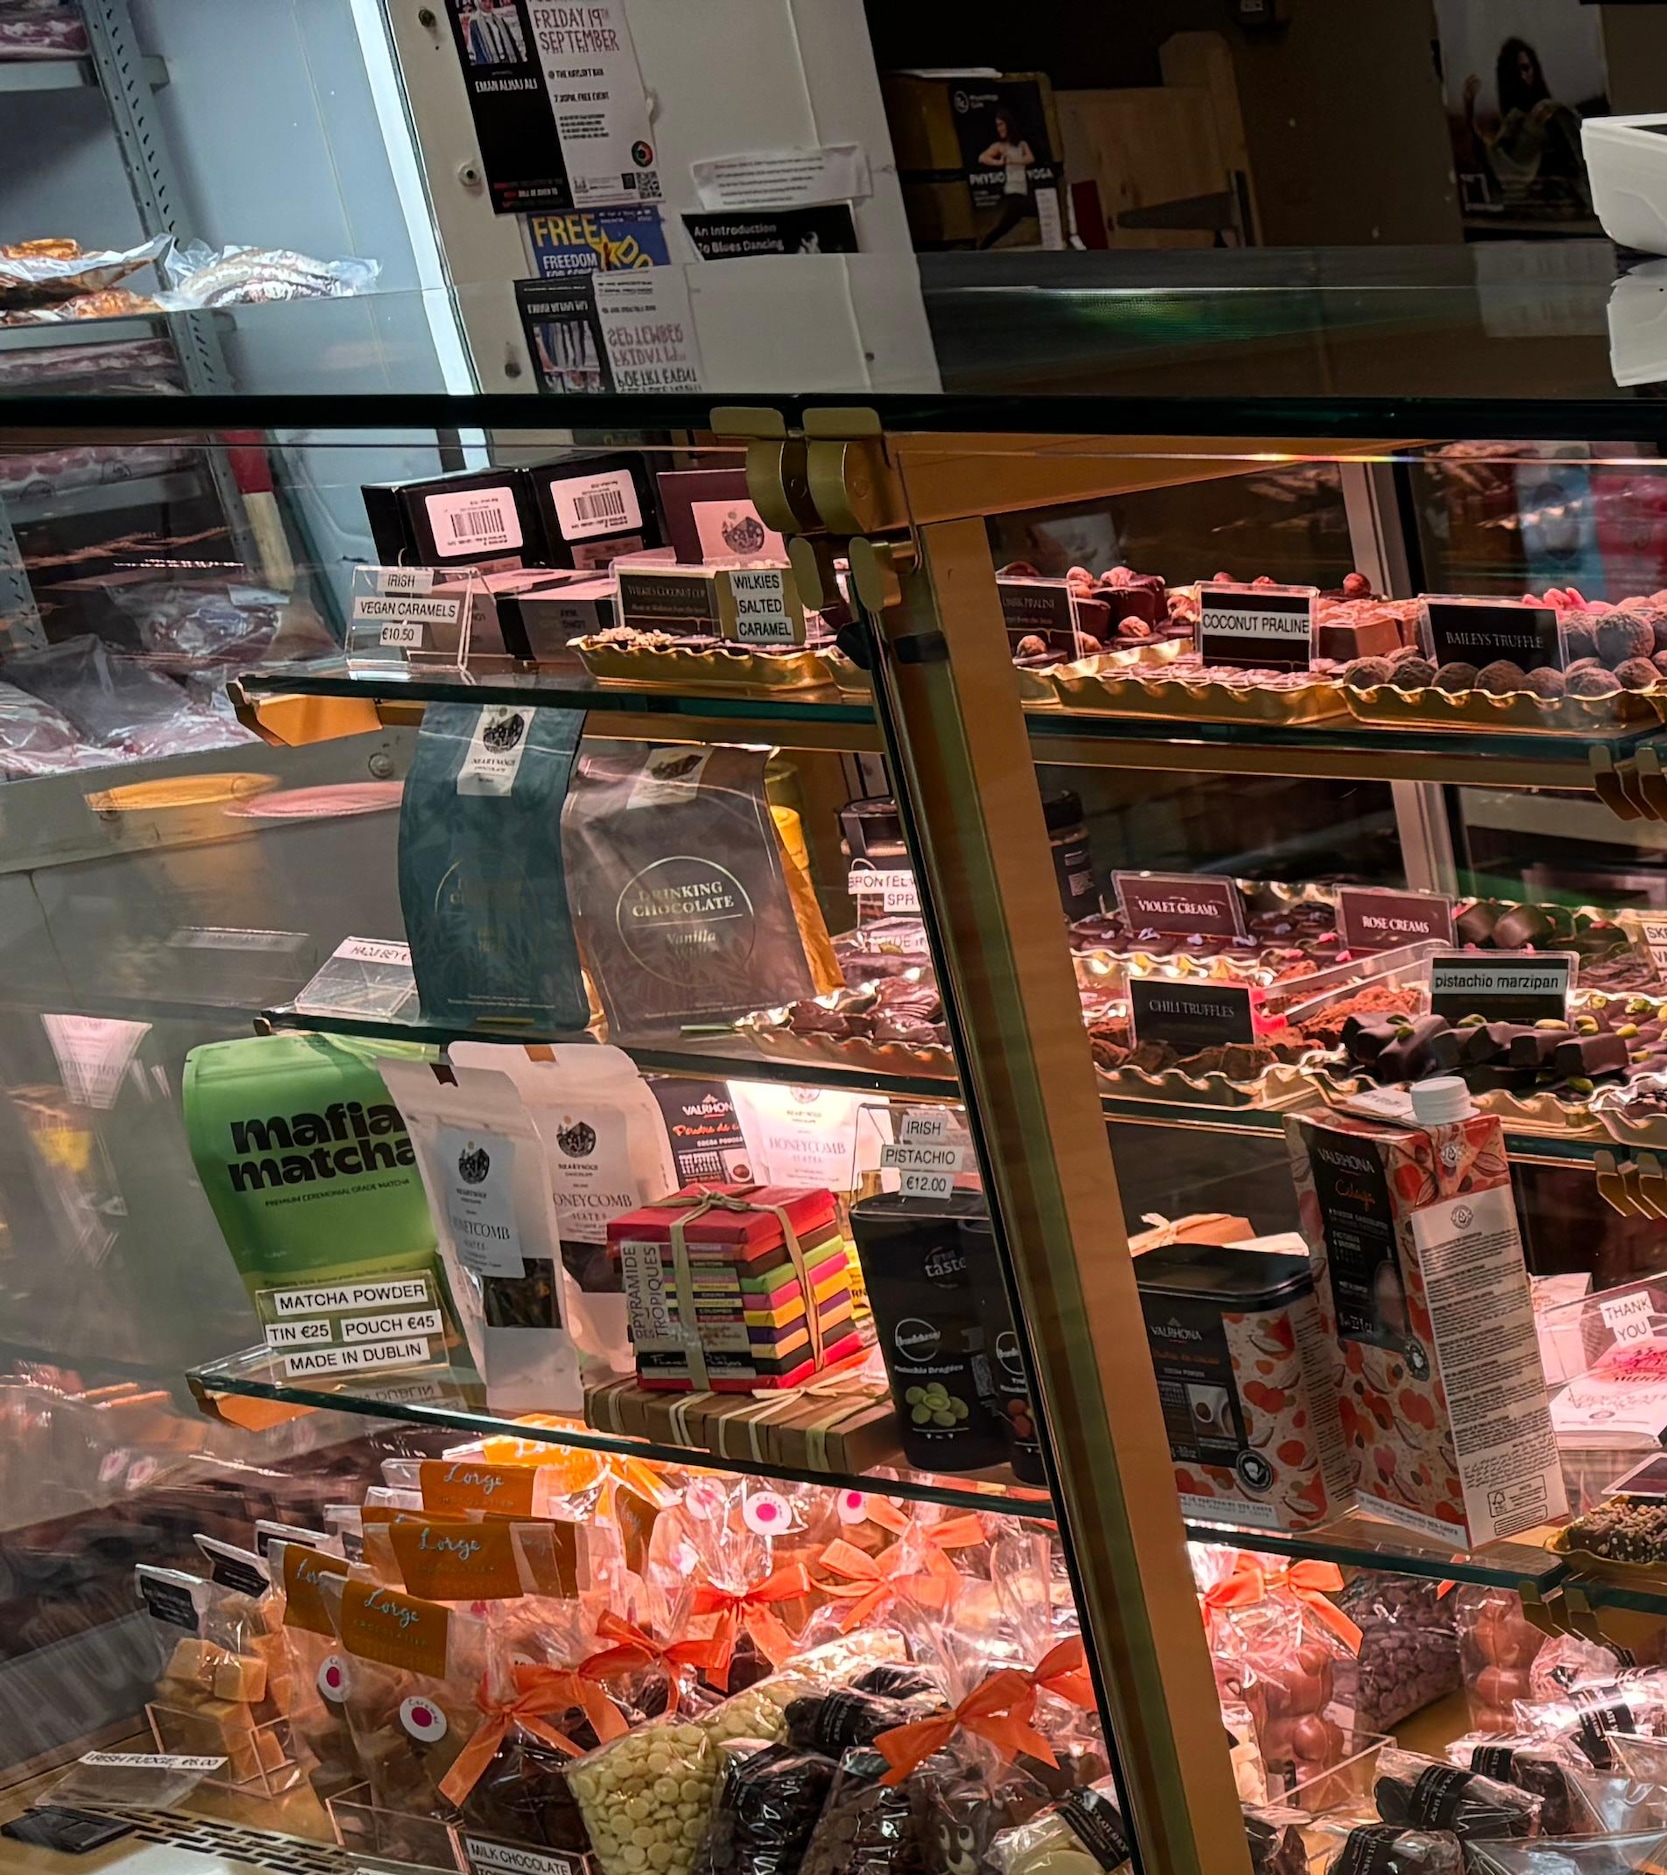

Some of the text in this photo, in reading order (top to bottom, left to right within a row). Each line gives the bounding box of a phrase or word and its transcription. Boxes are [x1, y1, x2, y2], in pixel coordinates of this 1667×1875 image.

[539, 29, 620, 53] SEPTEMBER
[694, 223, 777, 237] An Introduction
[712, 240, 742, 254] Blues
[743, 236, 785, 252] Dancing
[543, 252, 599, 270] FREEDOM
[387, 573, 415, 588] IRISH
[733, 573, 780, 590] WILKIES
[360, 601, 456, 619] VEGAN CARAMELS
[739, 598, 782, 615] SALTED
[738, 620, 792, 638] CARAMEL
[1202, 613, 1310, 635] COCONUT PRALINE
[381, 627, 415, 643] €10.50
[1446, 630, 1544, 650] BAILEYS TRUFFLE
[638, 881, 724, 901] DRINKING
[632, 895, 735, 919] CHOCOLATE
[666, 928, 717, 946] Vanilla
[1434, 973, 1559, 992] pistachio marzipan
[230, 1102, 403, 1154] mafia
[906, 1122, 942, 1136] IRISH
[228, 1137, 418, 1192] matcha
[885, 1149, 956, 1165] PISTACHIO
[1317, 1147, 1375, 1175] VALRHONA
[906, 1175, 947, 1193] €12.00
[279, 1282, 425, 1311] MATCHA POWDER
[1604, 1299, 1651, 1321] THANK
[269, 1322, 329, 1341] TIN €25
[344, 1314, 435, 1337] POUCH €45
[1616, 1321, 1648, 1342] YOU
[290, 1342, 422, 1371] MADE IN DUBLIN
[470, 1843, 499, 1861] MILK
